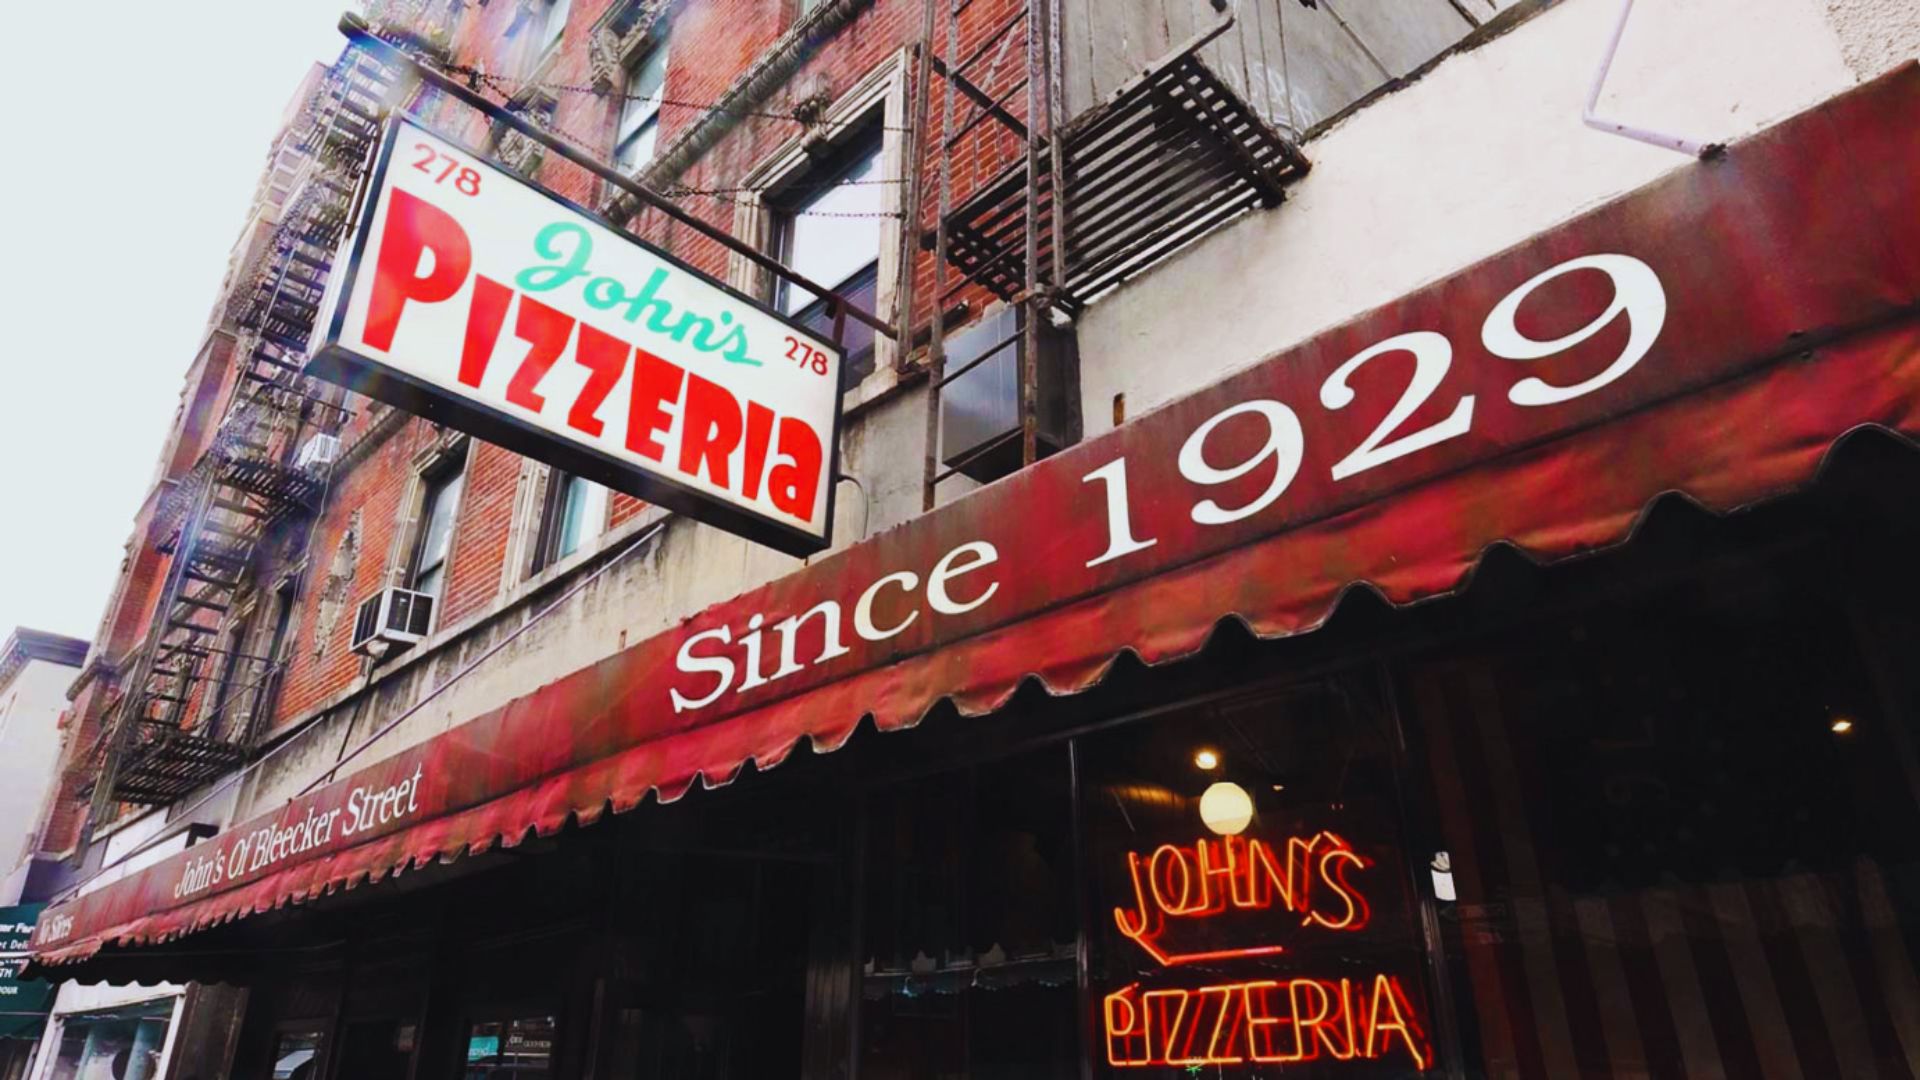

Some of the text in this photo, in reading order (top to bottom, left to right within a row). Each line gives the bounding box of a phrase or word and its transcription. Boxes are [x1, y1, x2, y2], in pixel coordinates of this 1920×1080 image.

[412, 142, 482, 198] 278
[514, 221, 764, 367] John's
[784, 335, 829, 377] 278
[669, 252, 1668, 714] Since 1929
[174, 763, 422, 898] John's Of Bleecker Street
[1113, 831, 1366, 938] JOHN'S
[1105, 974, 1426, 1071] PIZZERIA
